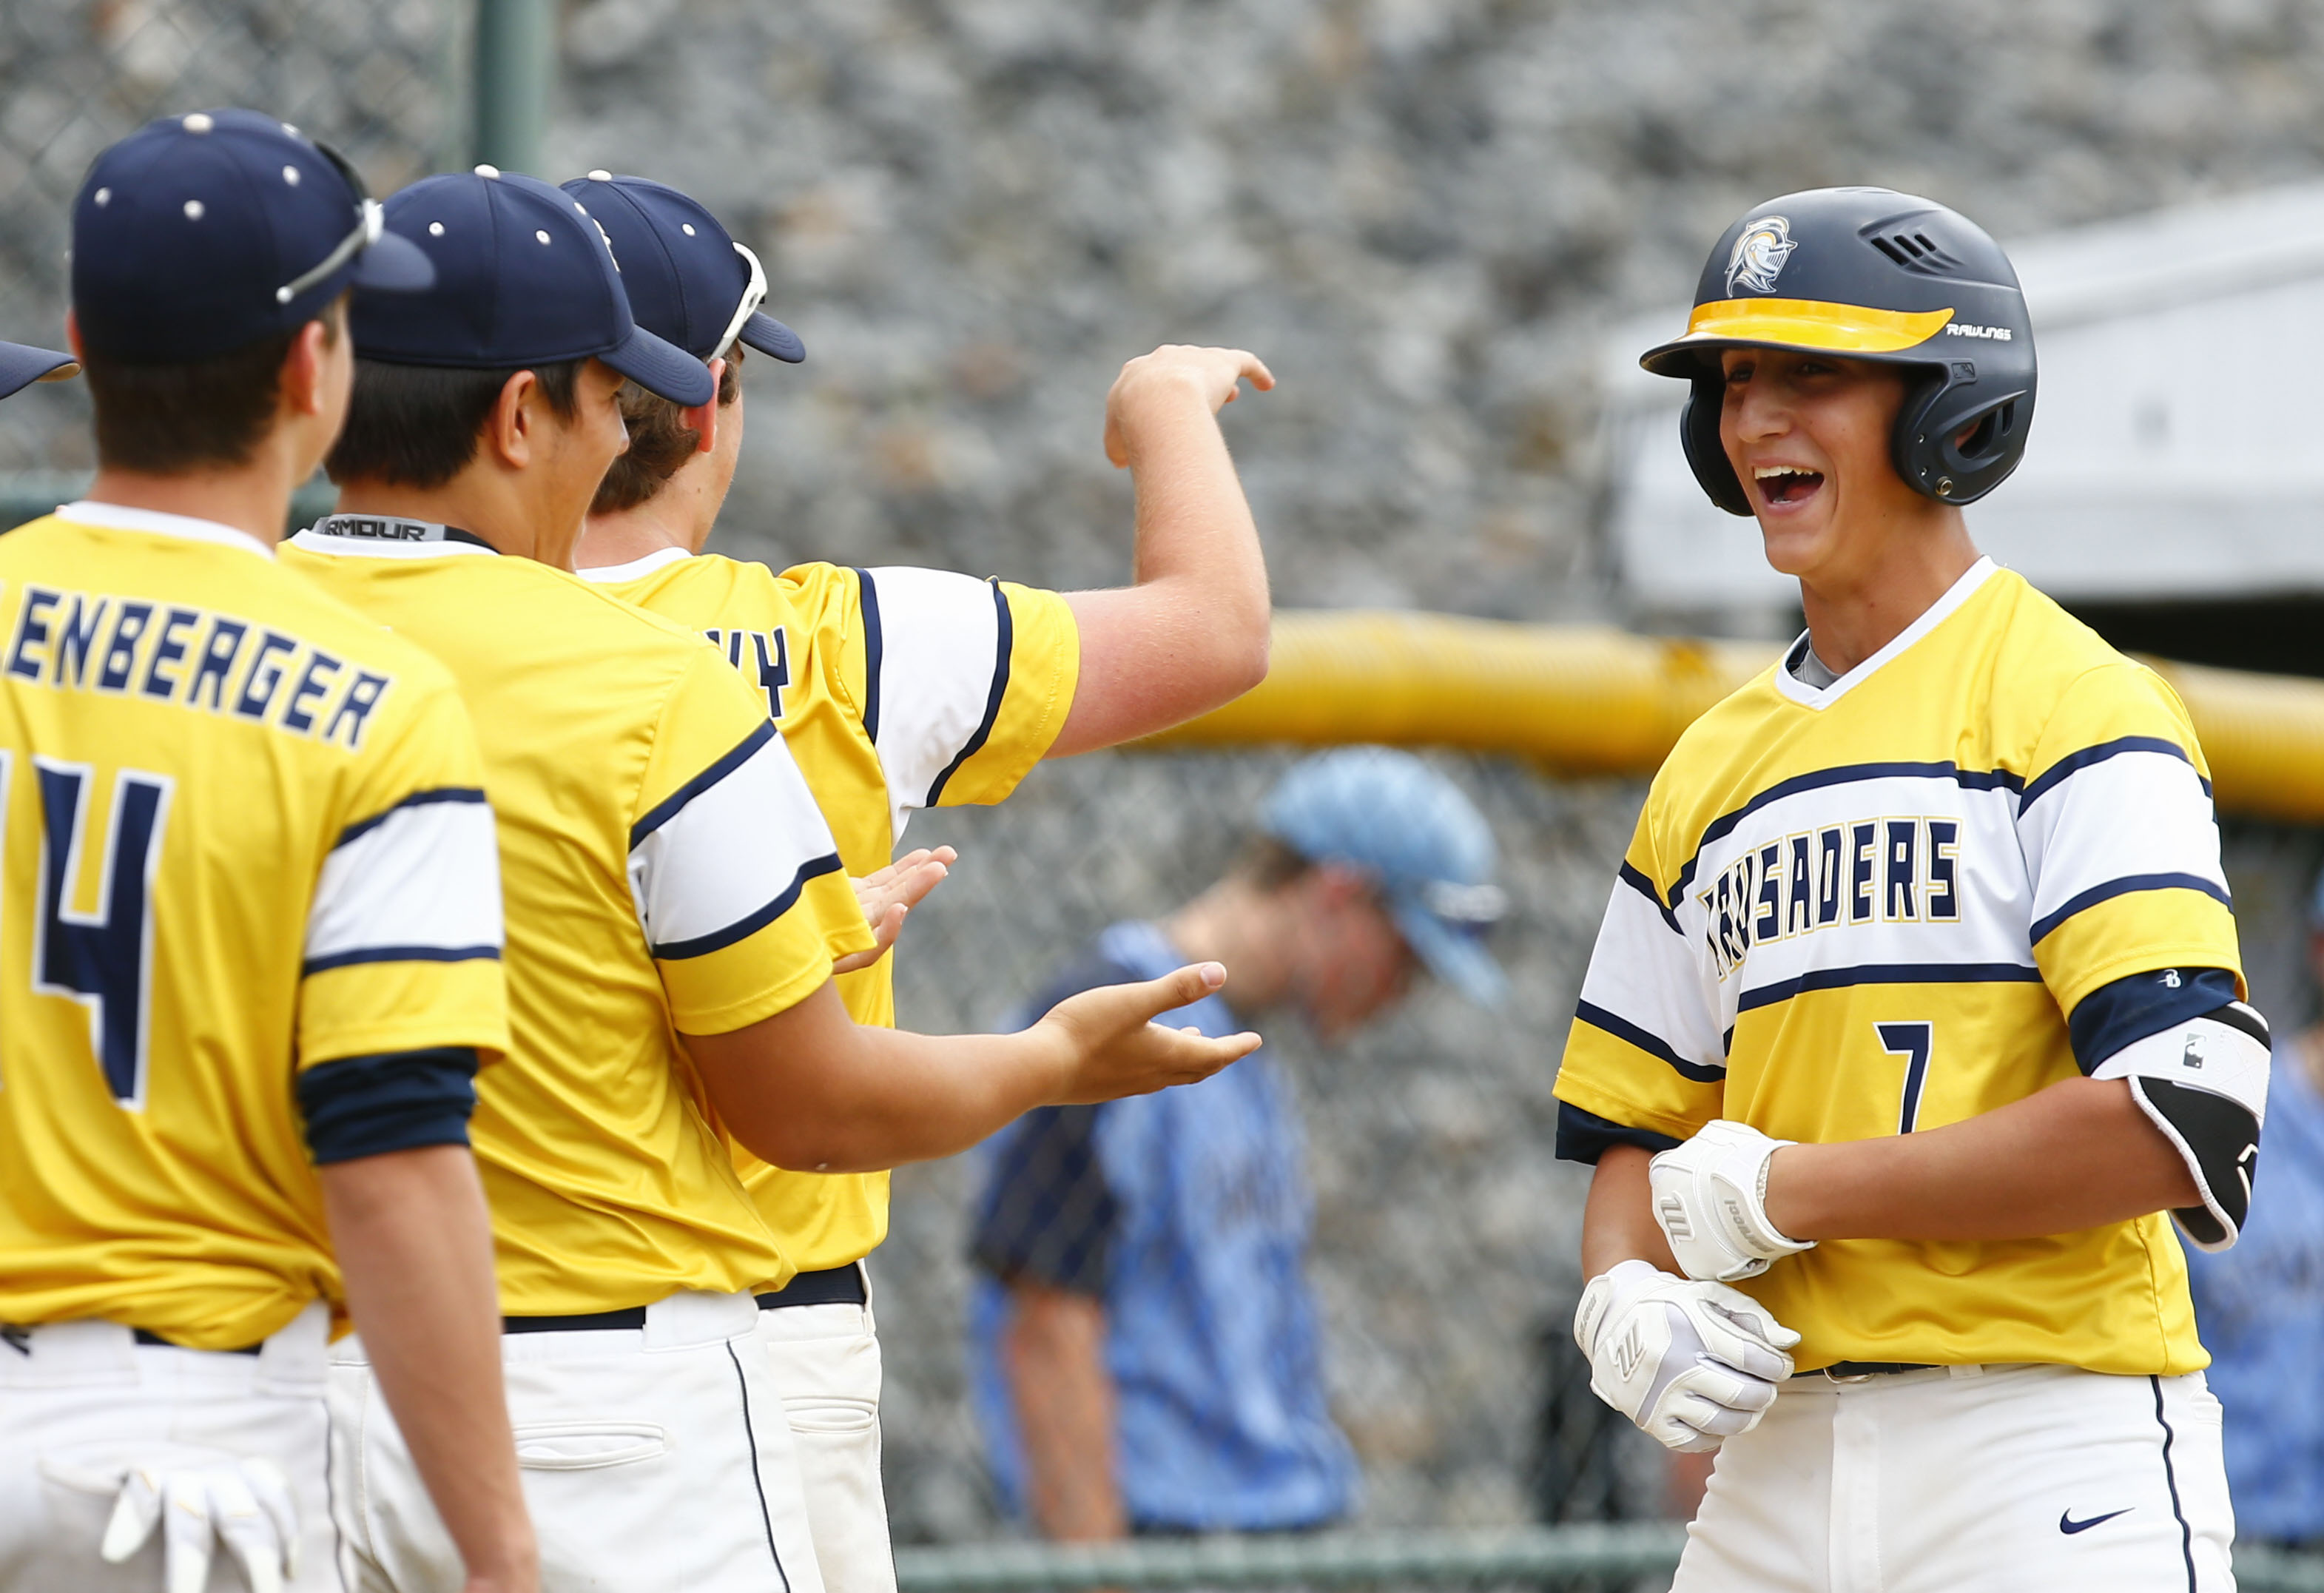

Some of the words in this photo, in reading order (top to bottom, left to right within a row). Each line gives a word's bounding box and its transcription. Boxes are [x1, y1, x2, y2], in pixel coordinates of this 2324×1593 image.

[1946, 323, 2012, 340] RAWLINGS
[321, 518, 426, 542] RMOUR
[0, 585, 393, 749] ENBERGER
[0, 750, 175, 1114] 4
[1872, 1020, 1933, 1135] 7
